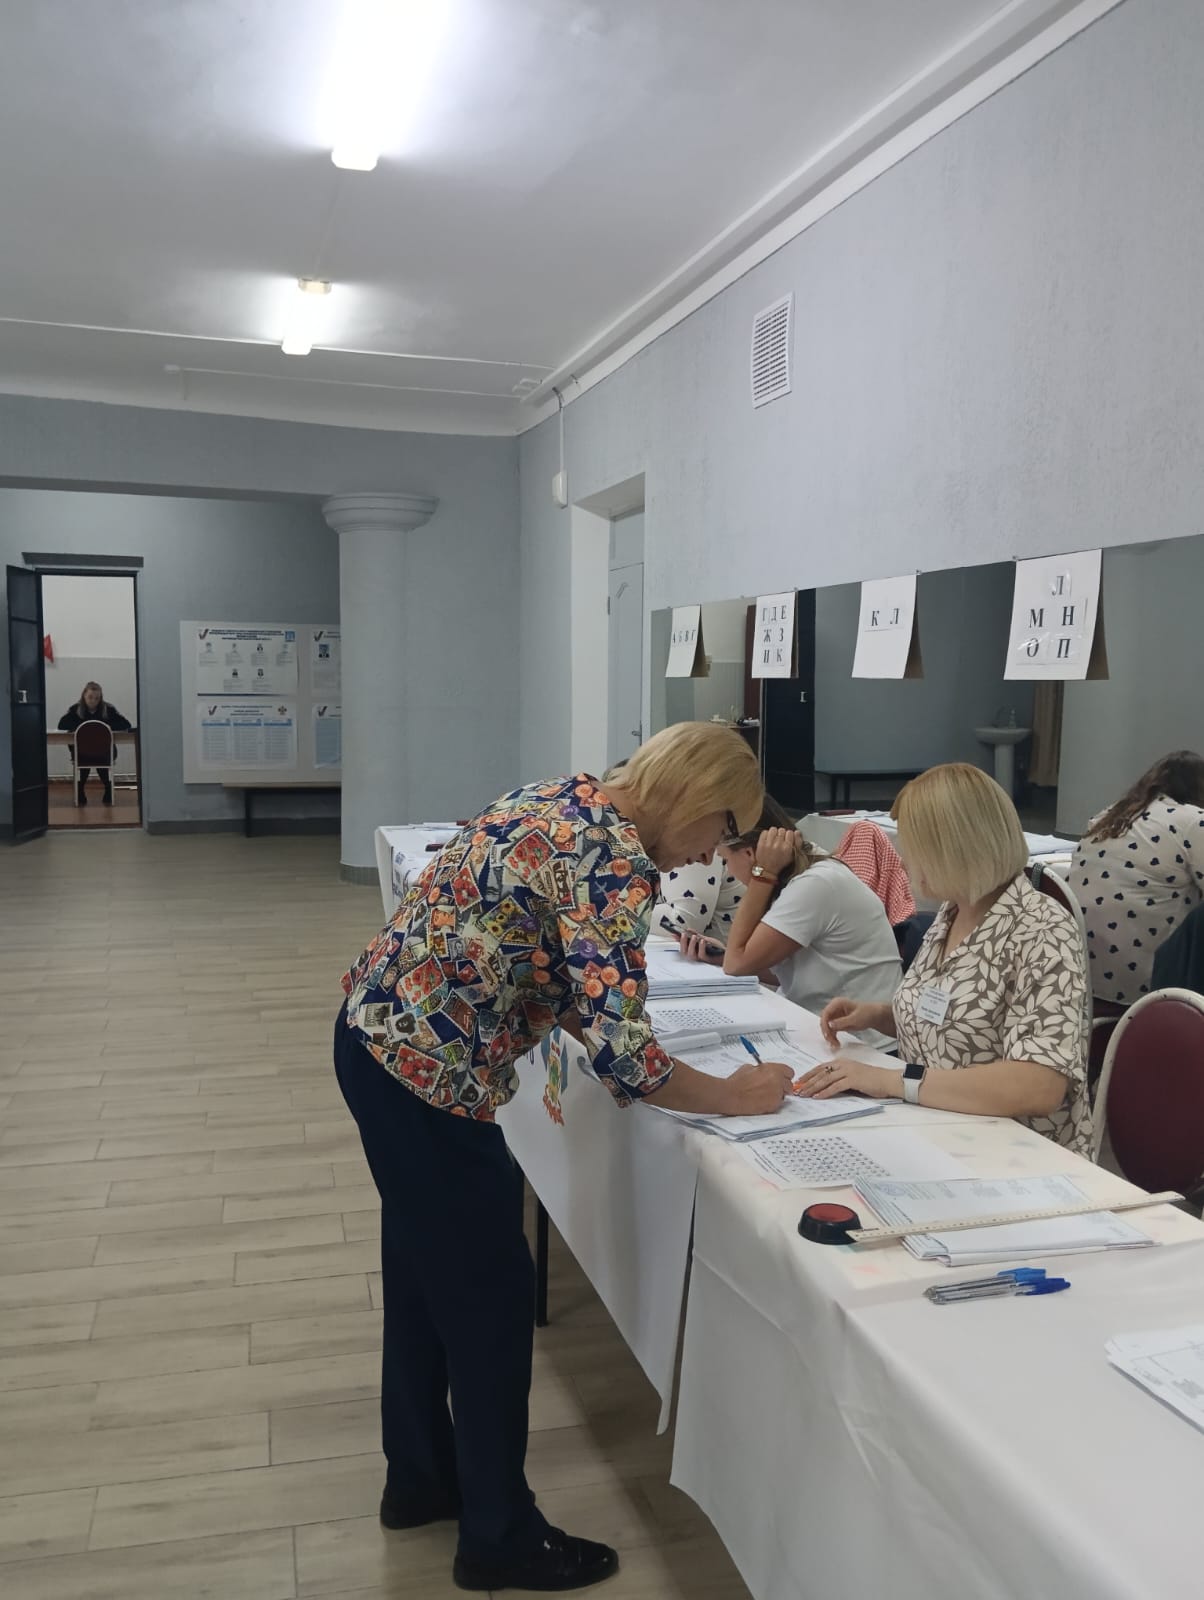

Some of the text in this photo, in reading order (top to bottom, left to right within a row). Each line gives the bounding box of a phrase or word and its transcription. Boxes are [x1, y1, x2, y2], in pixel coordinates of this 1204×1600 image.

[1051, 575, 1064, 596] Л
[871, 610, 880, 627] К
[1029, 605, 1075, 628] М Н
[1056, 638, 1071, 659] П
